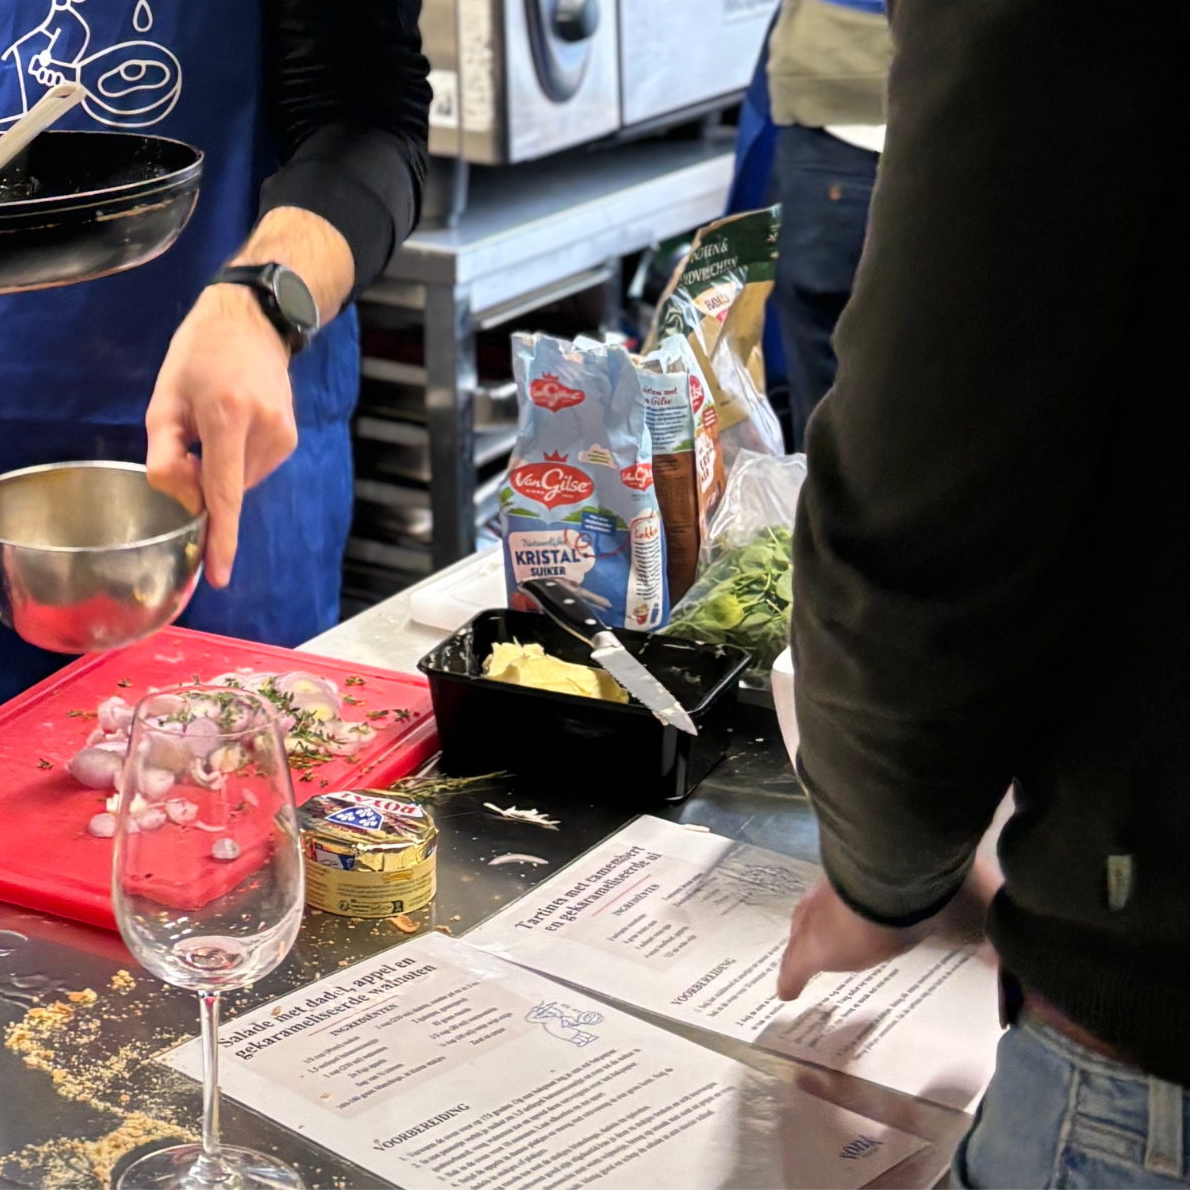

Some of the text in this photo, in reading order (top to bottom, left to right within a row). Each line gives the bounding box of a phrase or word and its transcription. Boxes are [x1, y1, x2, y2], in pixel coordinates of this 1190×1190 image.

[515, 468, 593, 502] Van Gilse
[515, 548, 581, 566] KRISTAL
[530, 566, 566, 577] SUIKER
[514, 845, 645, 929] Tartines met camembert
[544, 851, 662, 931] en gekarameliseerde ui
[218, 957, 416, 1048] Salade met dadel, appel en
[234, 994, 370, 1060] gekarameliseerde
[366, 964, 437, 994] walnoten
[372, 1103, 470, 1151] VOORBEREIDING
